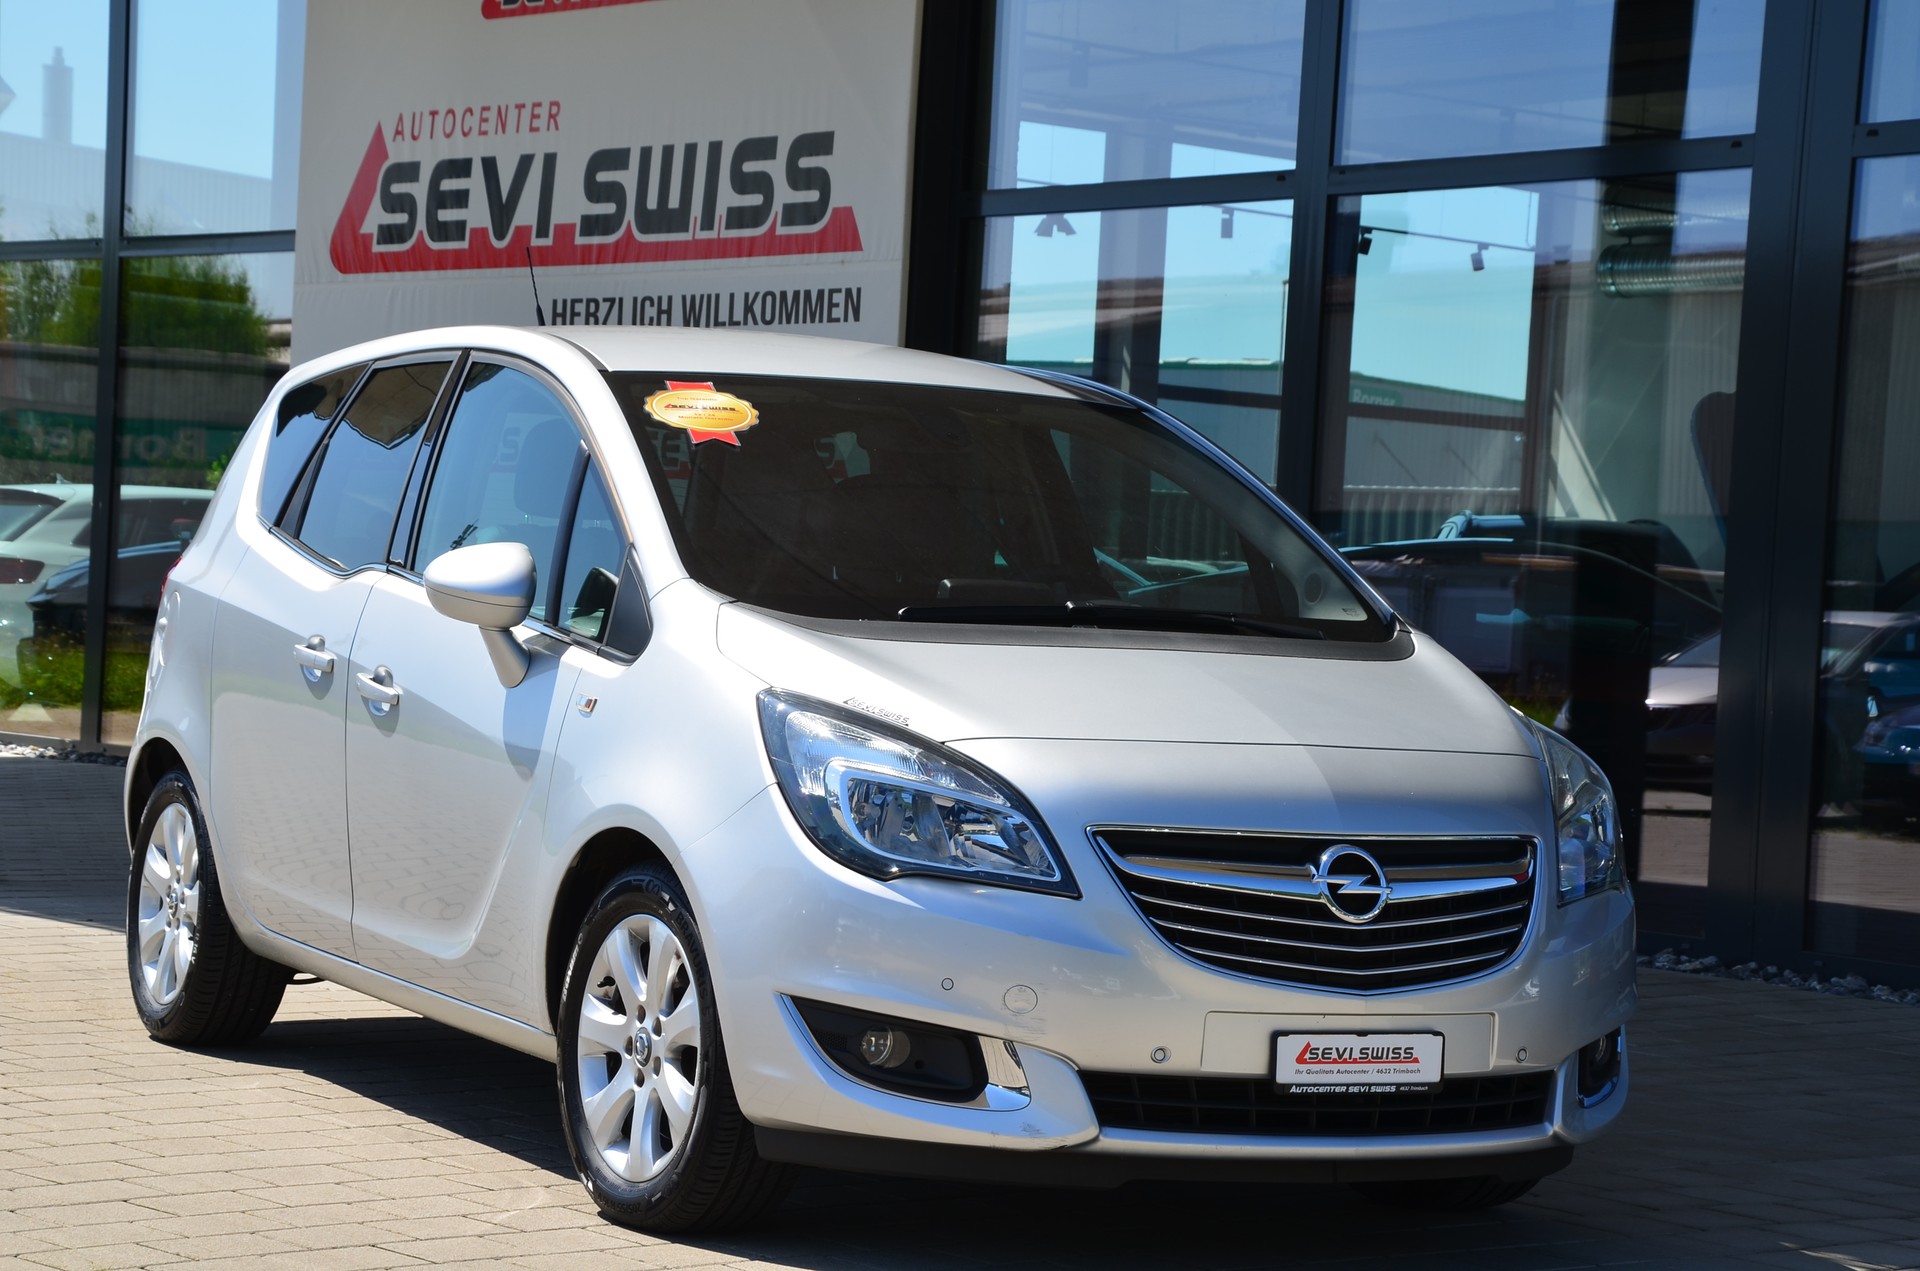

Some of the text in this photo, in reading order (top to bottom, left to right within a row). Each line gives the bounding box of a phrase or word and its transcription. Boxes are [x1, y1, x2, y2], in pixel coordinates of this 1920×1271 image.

[392, 101, 562, 143] AUTOCENTER
[376, 131, 835, 245] SEVI SWISS
[551, 287, 862, 328] HERZLICH WILLKOMMEN
[850, 699, 910, 723] SEVI SWISS
[1308, 1046, 1414, 1060] SEVI SWISS
[1376, 1067, 1391, 1075] 4632
[1392, 1067, 1421, 1075] Trimbach
[1348, 1085, 1369, 1093] SEVI
[1370, 1085, 1396, 1093] SWISS
